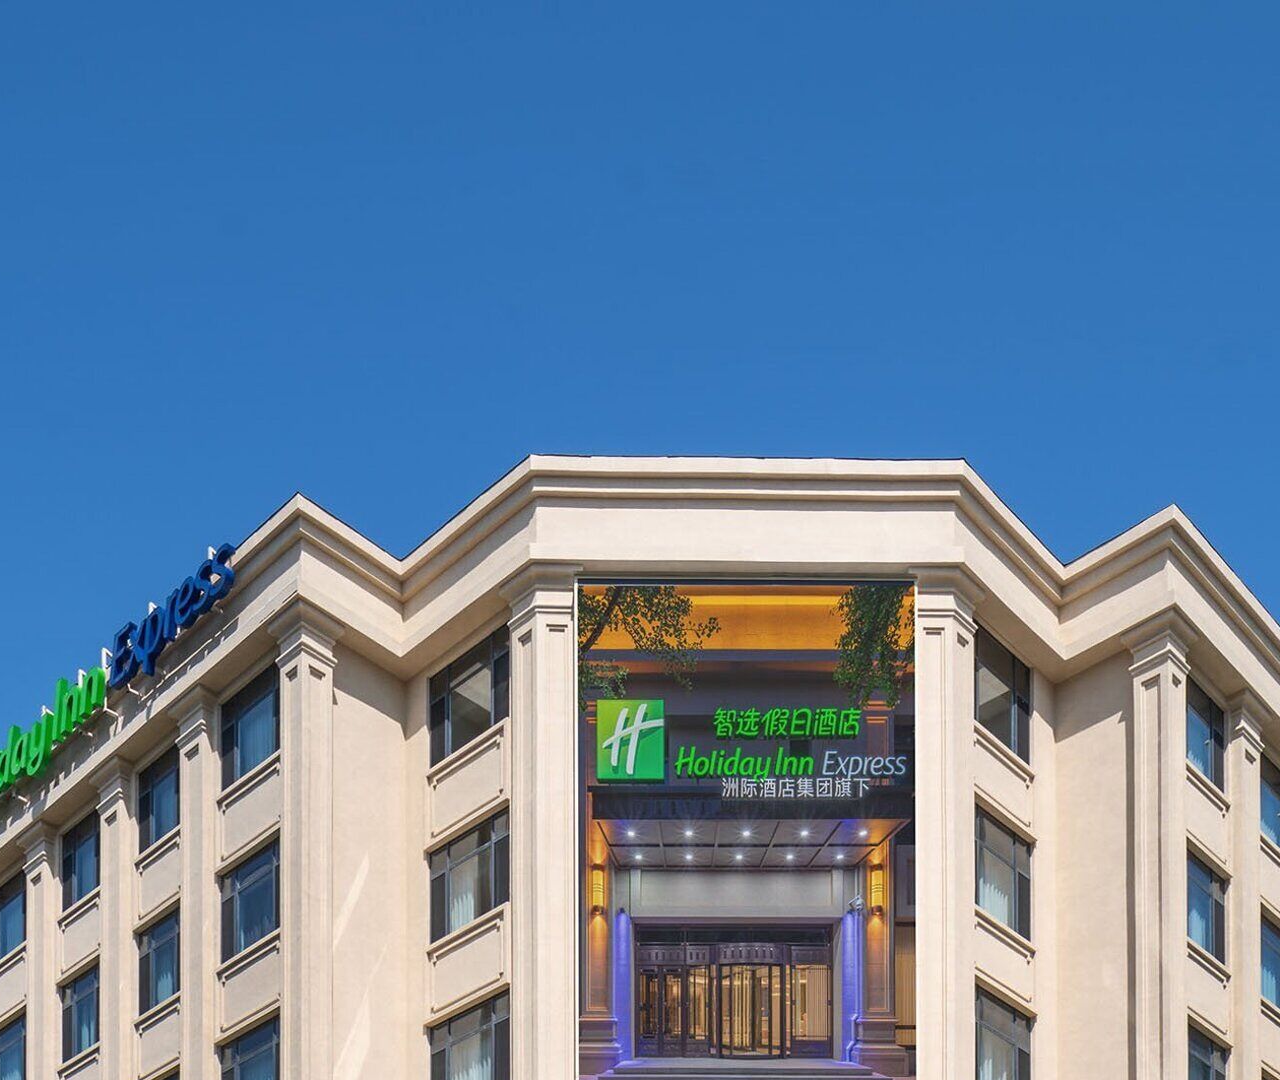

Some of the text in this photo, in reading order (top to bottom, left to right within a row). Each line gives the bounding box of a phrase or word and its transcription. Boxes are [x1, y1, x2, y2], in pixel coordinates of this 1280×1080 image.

[51, 667, 106, 743] Inn
[109, 543, 236, 689] Express
[713, 707, 861, 741] 智选假日酒店
[675, 746, 906, 784] Holiday Inn Express
[721, 777, 871, 799] 洲际酒店集团旗下
